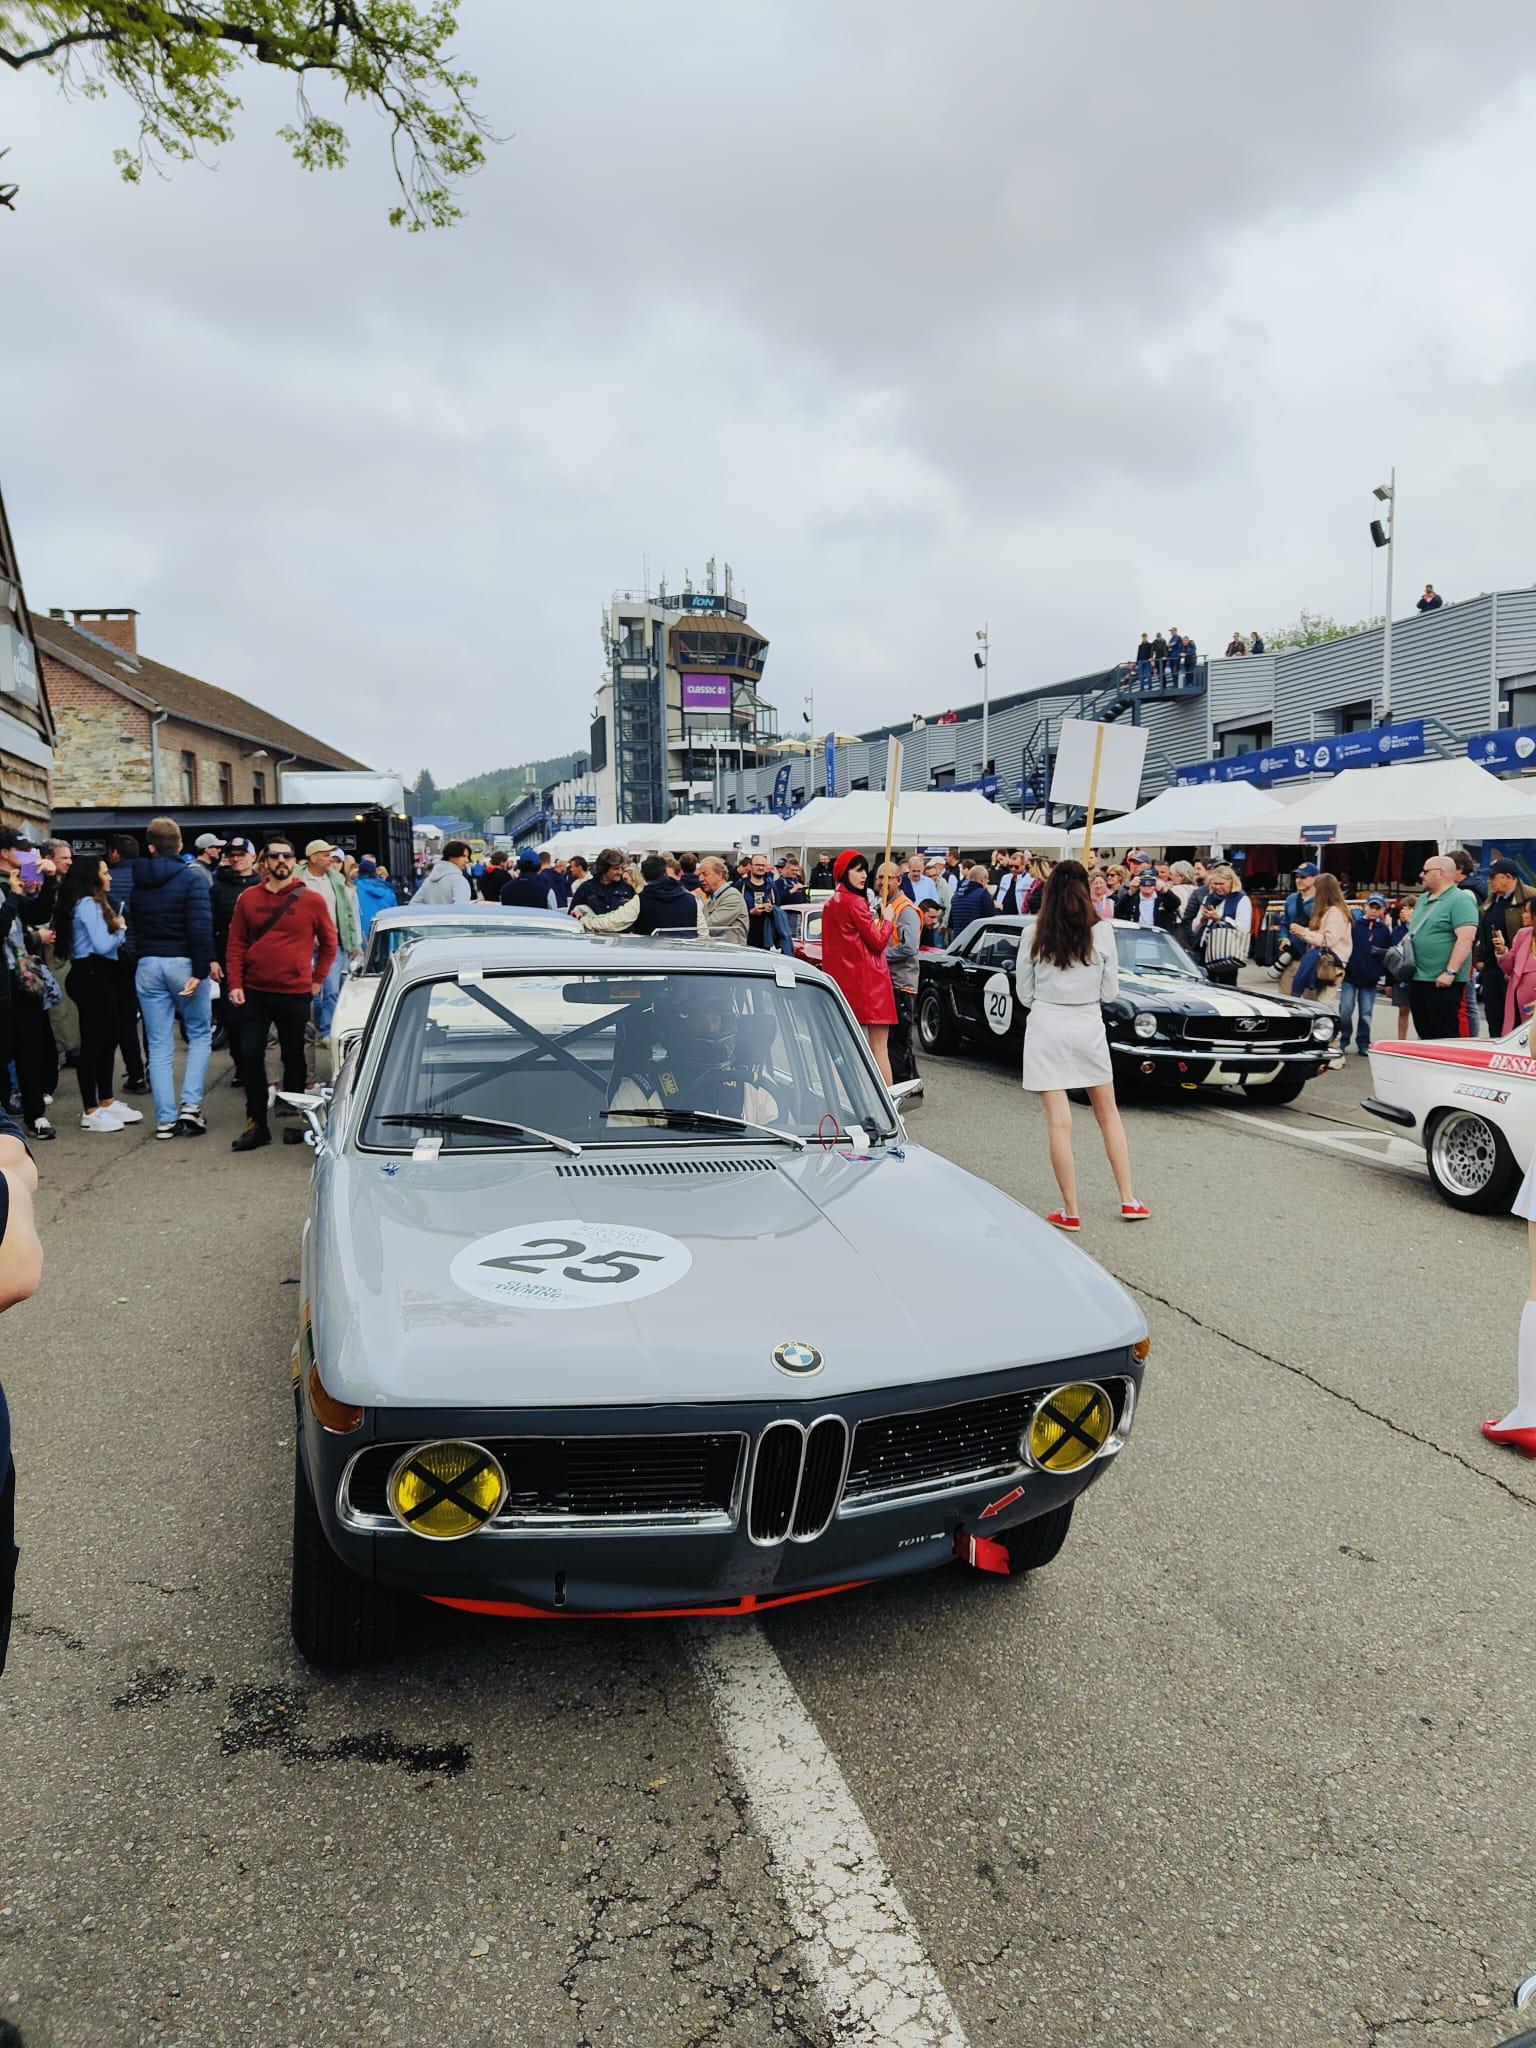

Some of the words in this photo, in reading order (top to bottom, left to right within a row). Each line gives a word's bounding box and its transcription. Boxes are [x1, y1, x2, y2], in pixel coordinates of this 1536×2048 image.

[990, 993, 1007, 1018] 20
[662, 1072, 677, 1095] OMP
[477, 1238, 665, 1284] 25
[495, 1284, 562, 1299] TOURING
[507, 1280, 563, 1293] CLASSIC
